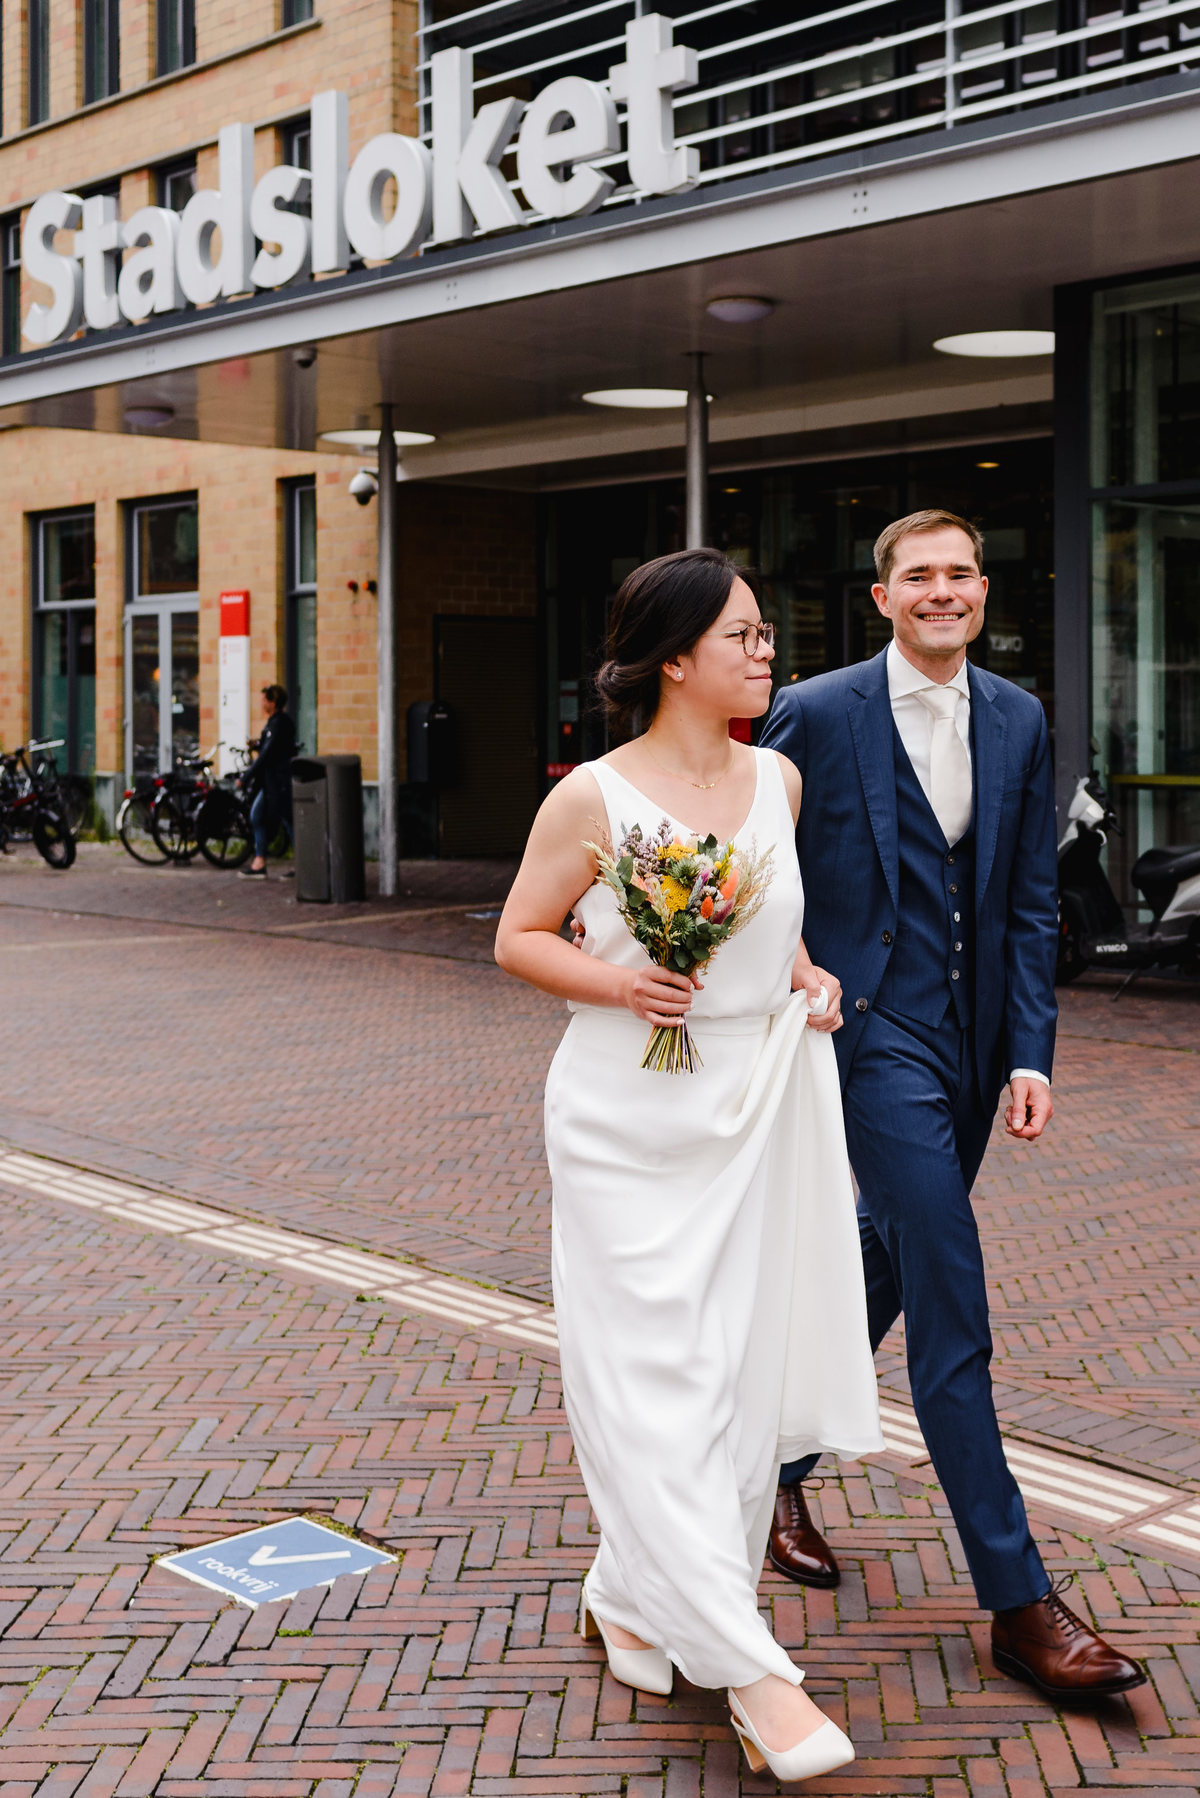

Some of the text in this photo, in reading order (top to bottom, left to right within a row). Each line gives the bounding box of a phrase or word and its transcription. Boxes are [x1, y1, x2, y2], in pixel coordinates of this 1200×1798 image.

[22, 12, 699, 344] Stadsloket
[1096, 943, 1128, 953] KYMCO
[198, 1557, 279, 1594] rookvrij
